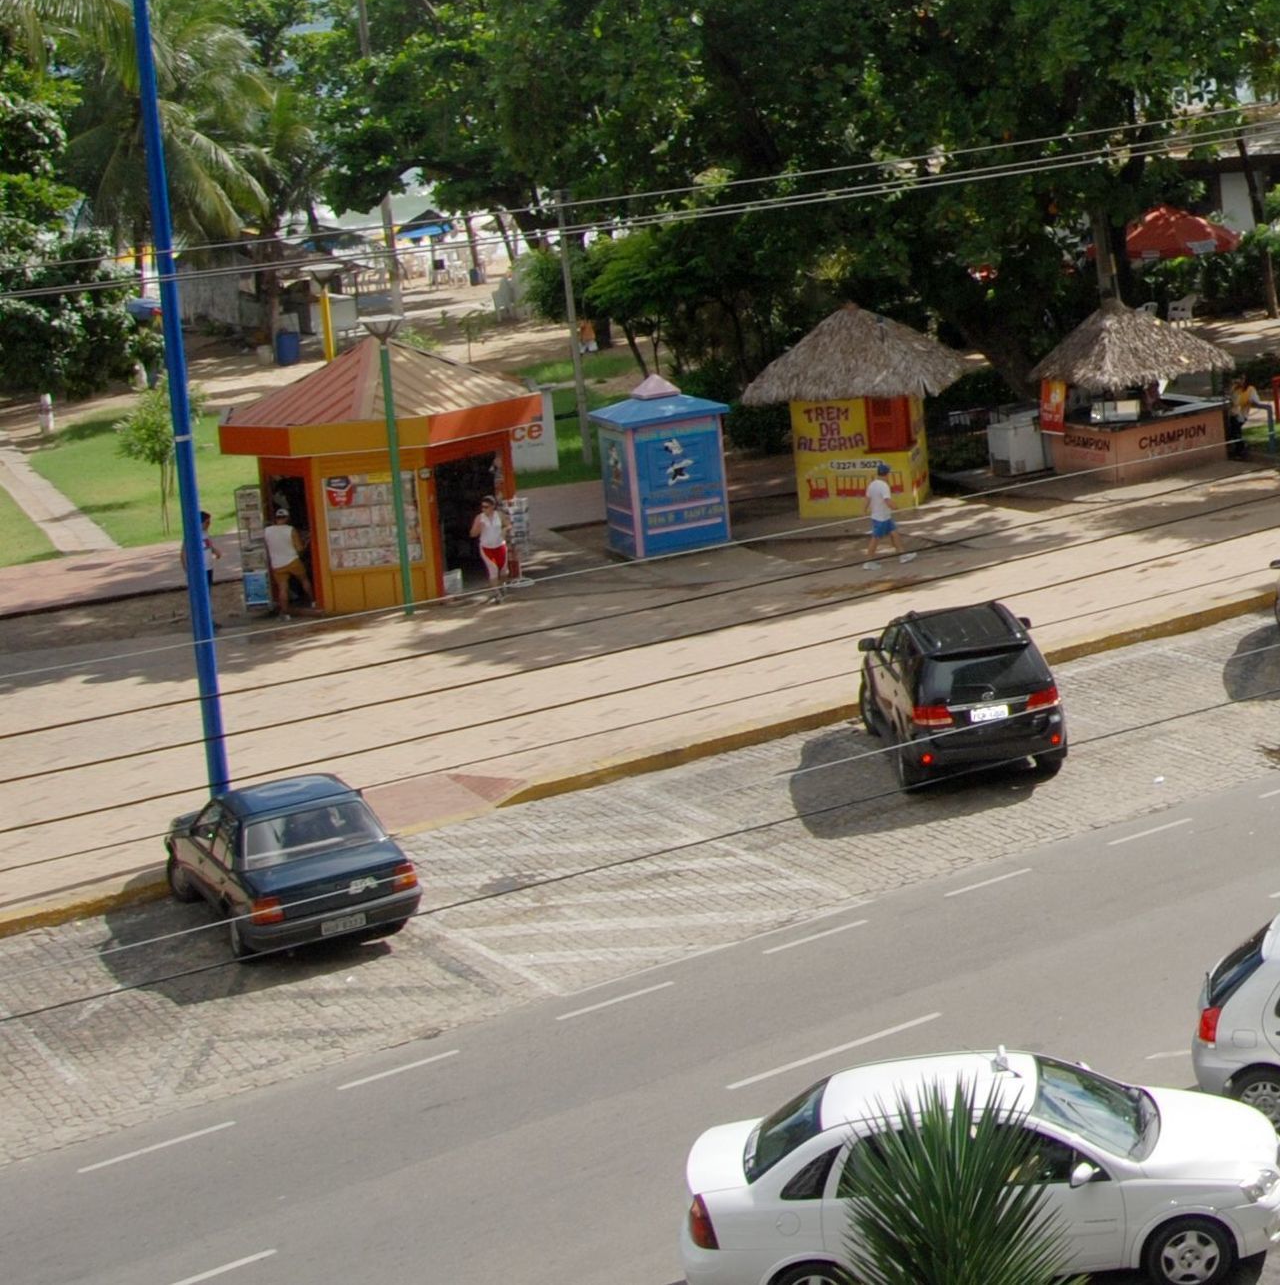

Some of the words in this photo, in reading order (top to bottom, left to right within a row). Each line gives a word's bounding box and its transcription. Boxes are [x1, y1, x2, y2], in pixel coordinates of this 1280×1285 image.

[803, 406, 849, 423] TREM
[819, 422, 841, 436] DA
[1139, 423, 1206, 450] CHAMPION
[797, 433, 866, 452] ALEGRIA
[1063, 433, 1111, 452] CHAMPION
